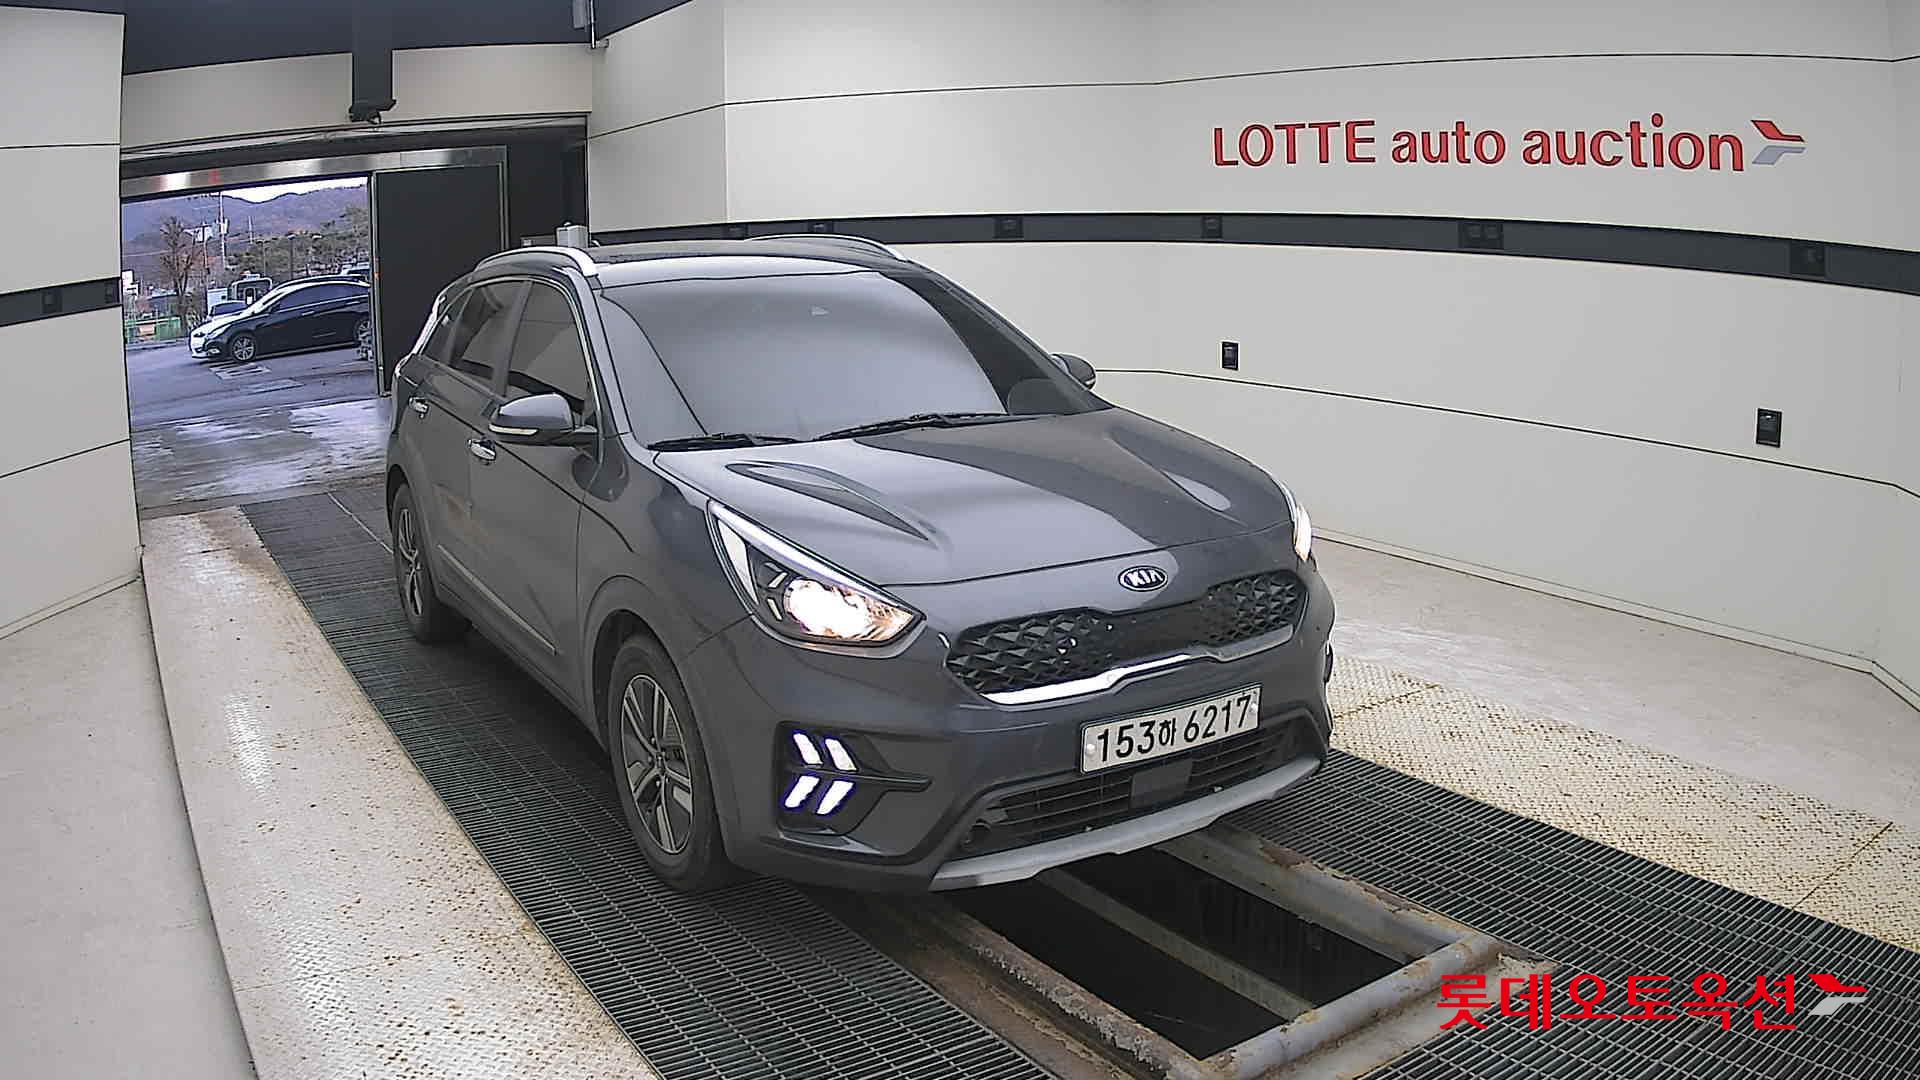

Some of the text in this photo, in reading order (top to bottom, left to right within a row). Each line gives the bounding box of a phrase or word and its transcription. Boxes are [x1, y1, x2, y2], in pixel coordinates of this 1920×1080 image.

[1213, 112, 1744, 171] LOTTE auto auction
[1124, 568, 1164, 587] KIA
[1097, 695, 1252, 762] 153하 6217
